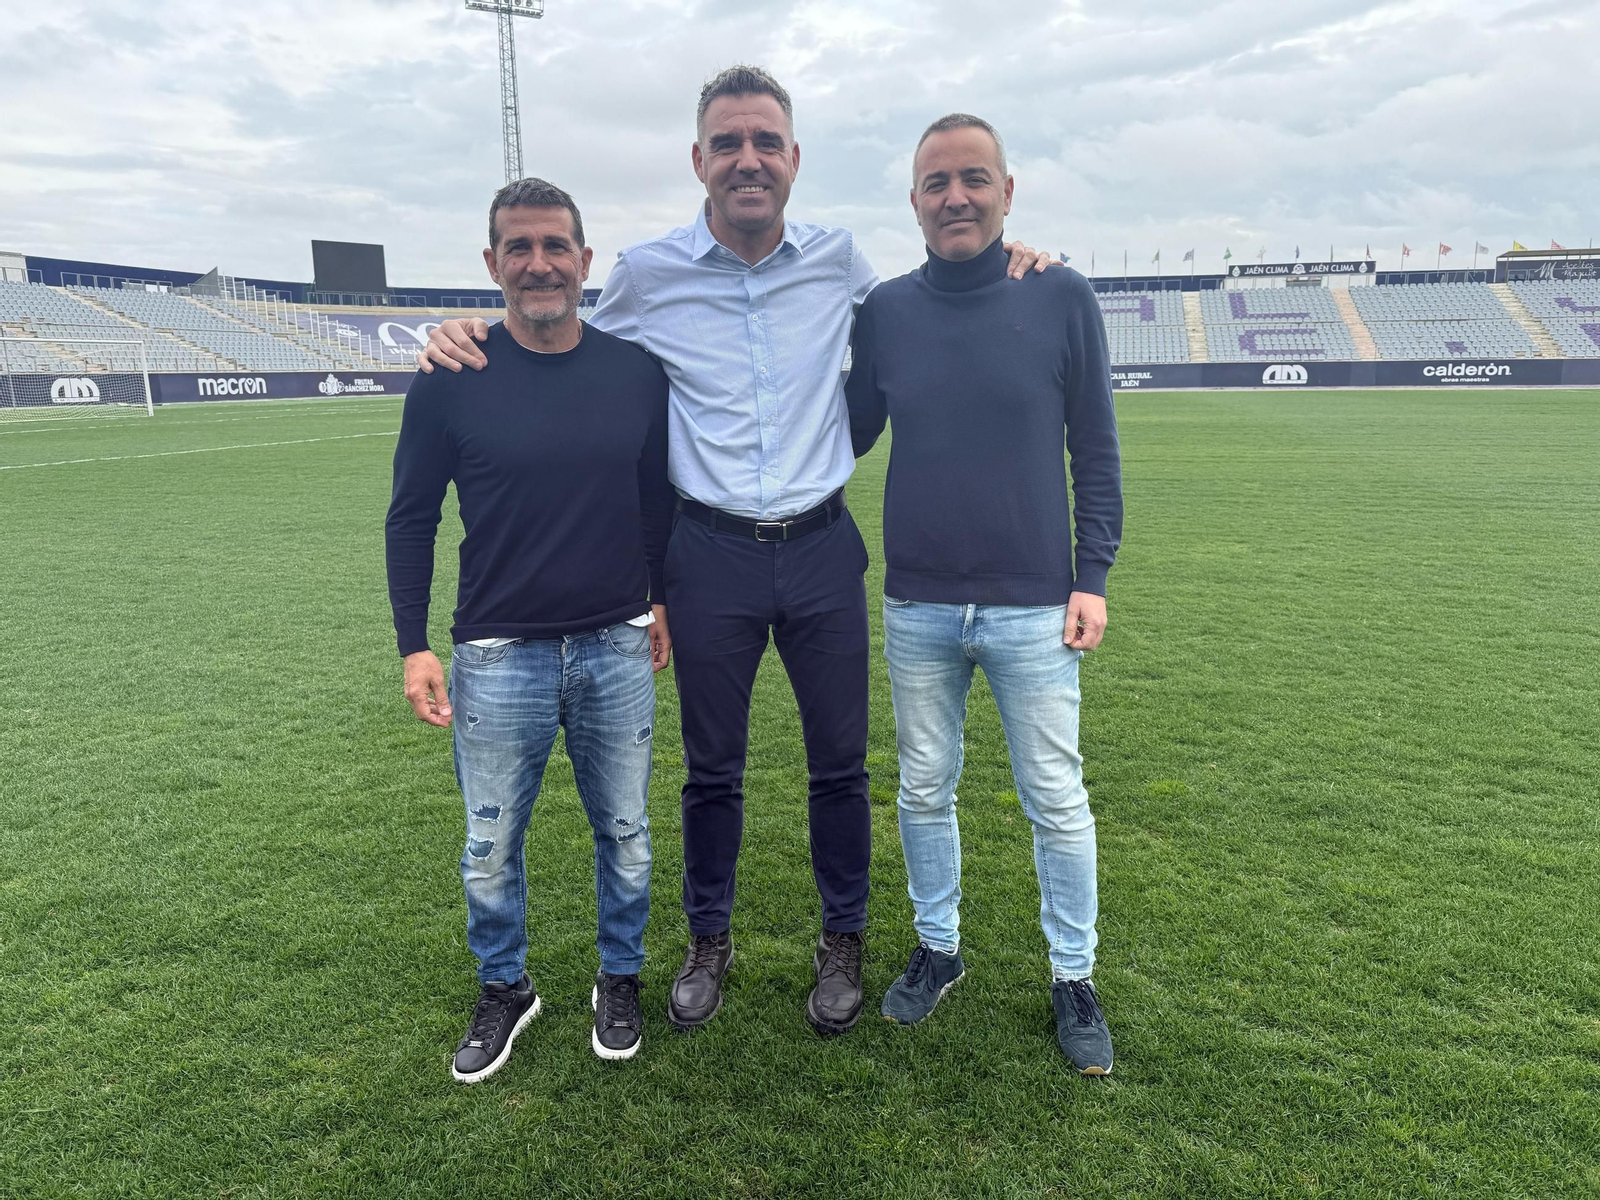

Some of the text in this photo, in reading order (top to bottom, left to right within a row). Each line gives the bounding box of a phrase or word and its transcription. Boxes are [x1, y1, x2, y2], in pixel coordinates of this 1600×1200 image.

[1244, 265, 1289, 275] JAÉN CLIMA
[1309, 263, 1355, 273] JAÉN CLIMA
[1127, 371, 1153, 379] RURAL
[197, 377, 268, 396] macron
[369, 384, 385, 392] MORA
